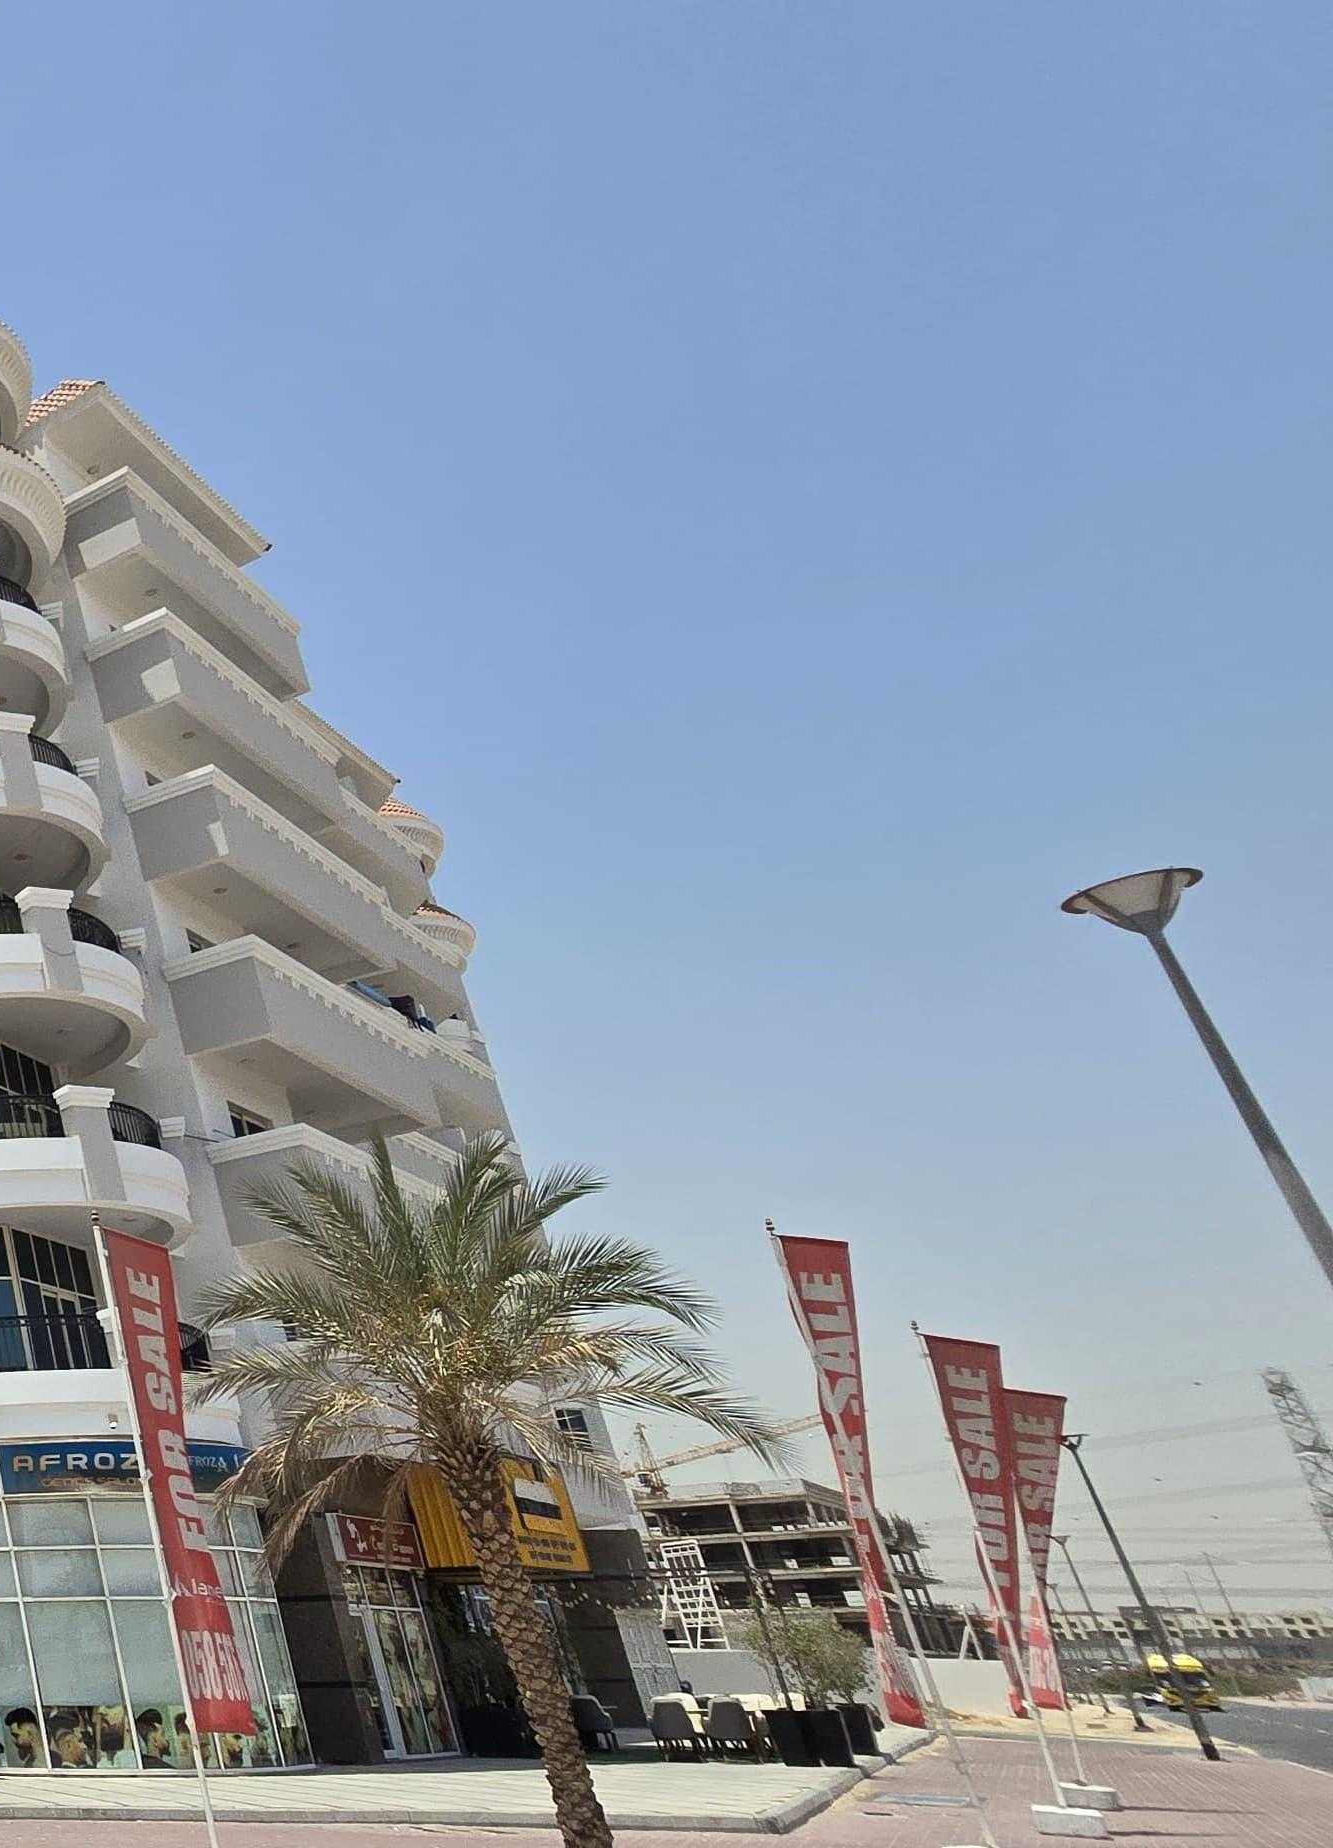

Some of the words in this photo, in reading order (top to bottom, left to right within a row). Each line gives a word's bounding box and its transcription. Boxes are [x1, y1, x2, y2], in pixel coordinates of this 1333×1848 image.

[126, 1268, 177, 1415] SALE
[800, 1272, 860, 1416] SALE
[12, 1452, 140, 1473] AFROZ
[188, 1455, 229, 1472] FROZA
[944, 1364, 1001, 1480] SALE
[1012, 1409, 1056, 1512] SALE
